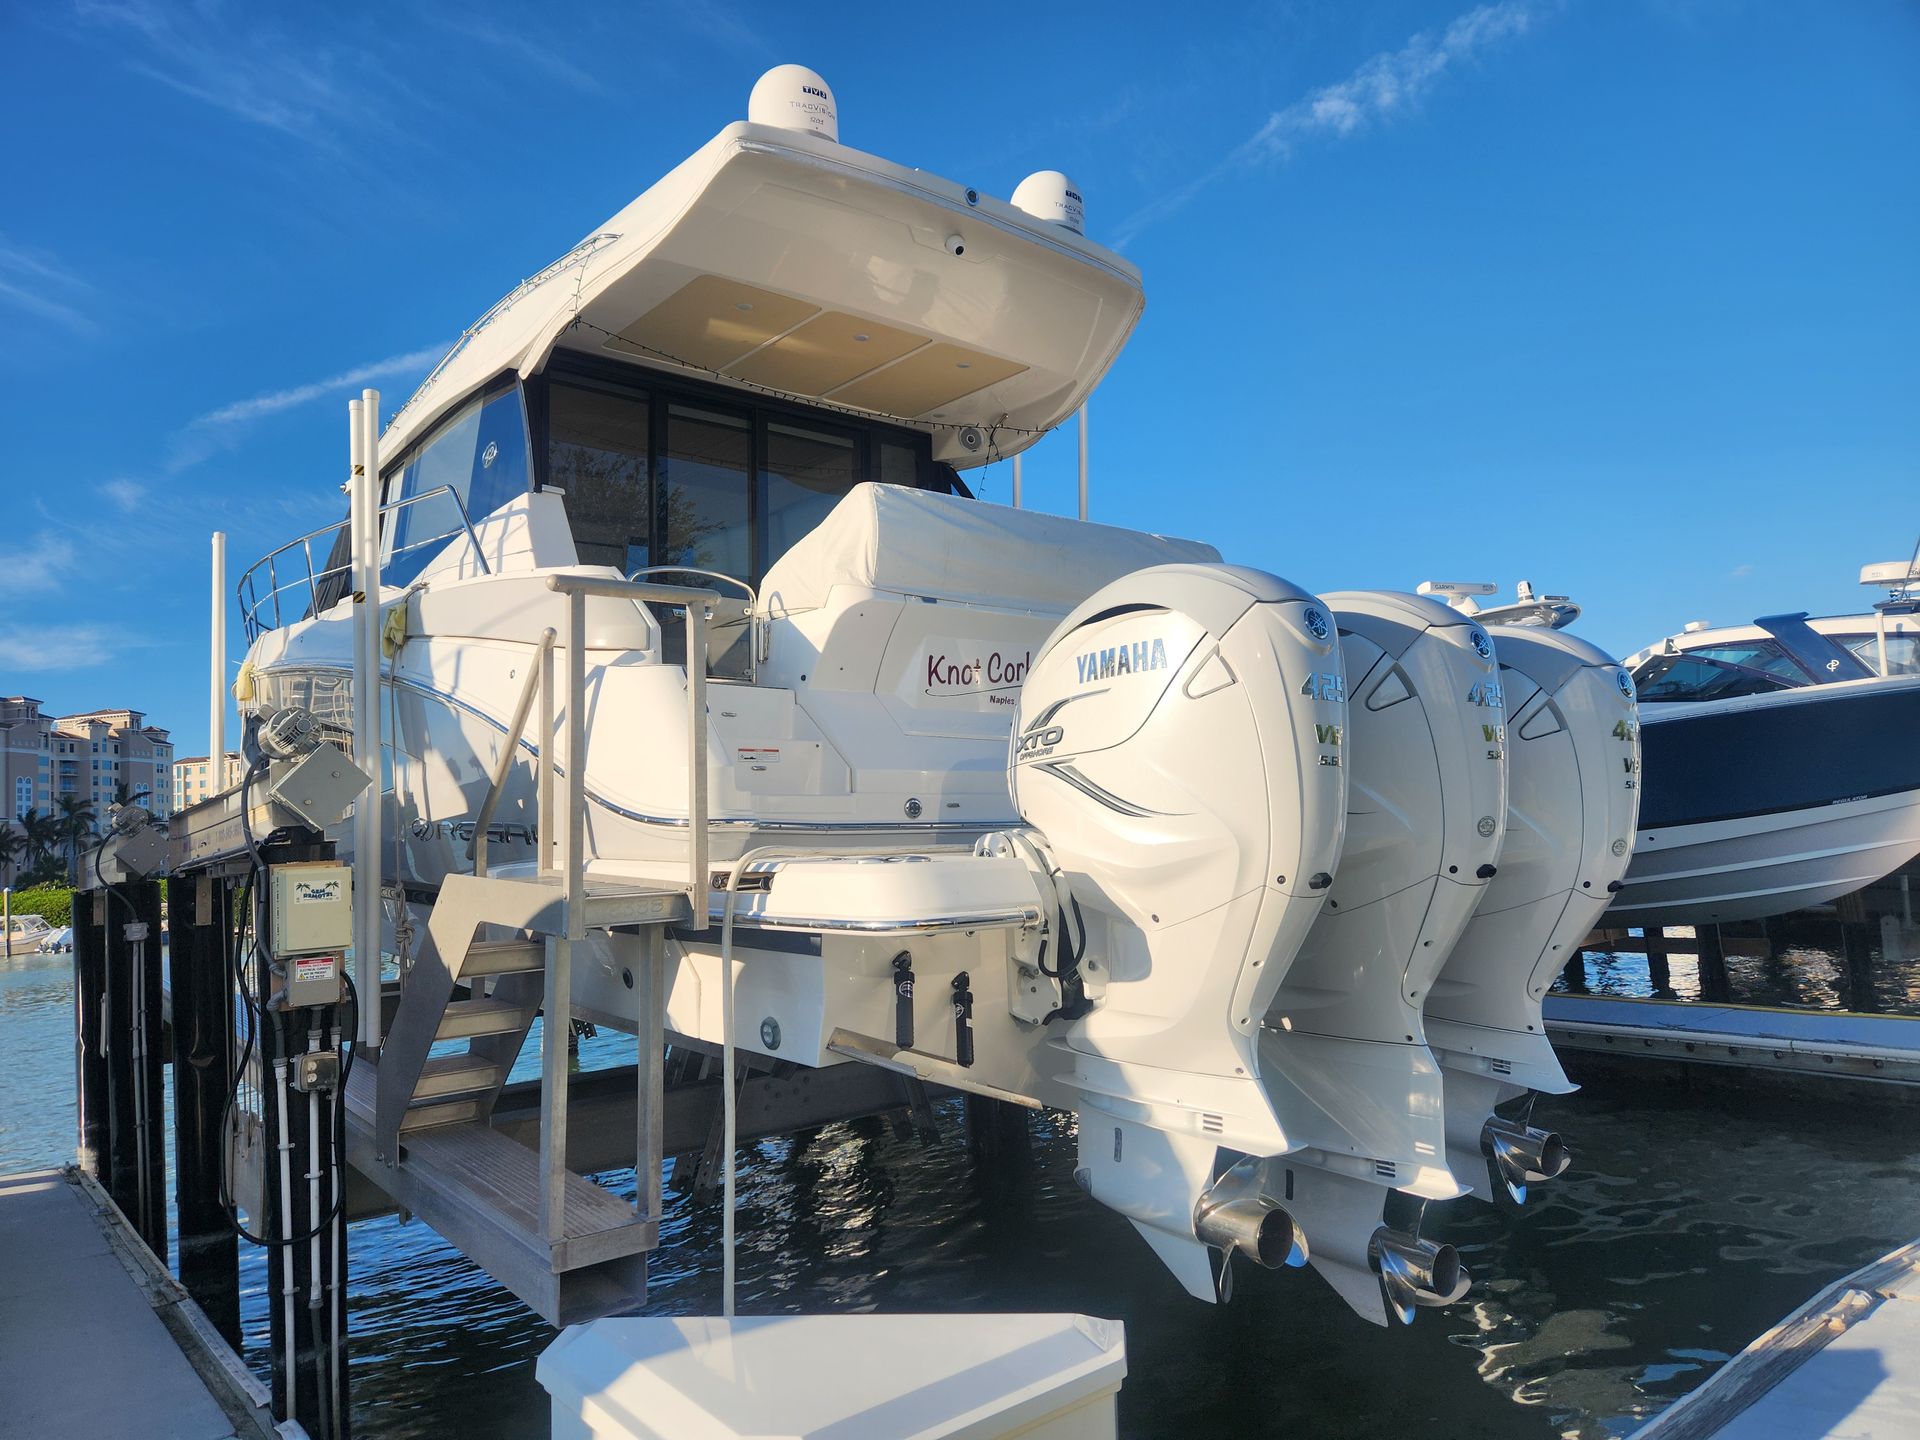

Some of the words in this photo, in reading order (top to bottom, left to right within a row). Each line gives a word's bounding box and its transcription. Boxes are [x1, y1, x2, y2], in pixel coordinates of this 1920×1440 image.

[927, 654, 981, 687] Knot
[1076, 638, 1168, 684] YAMAHA
[1015, 725, 1064, 754] XTO
